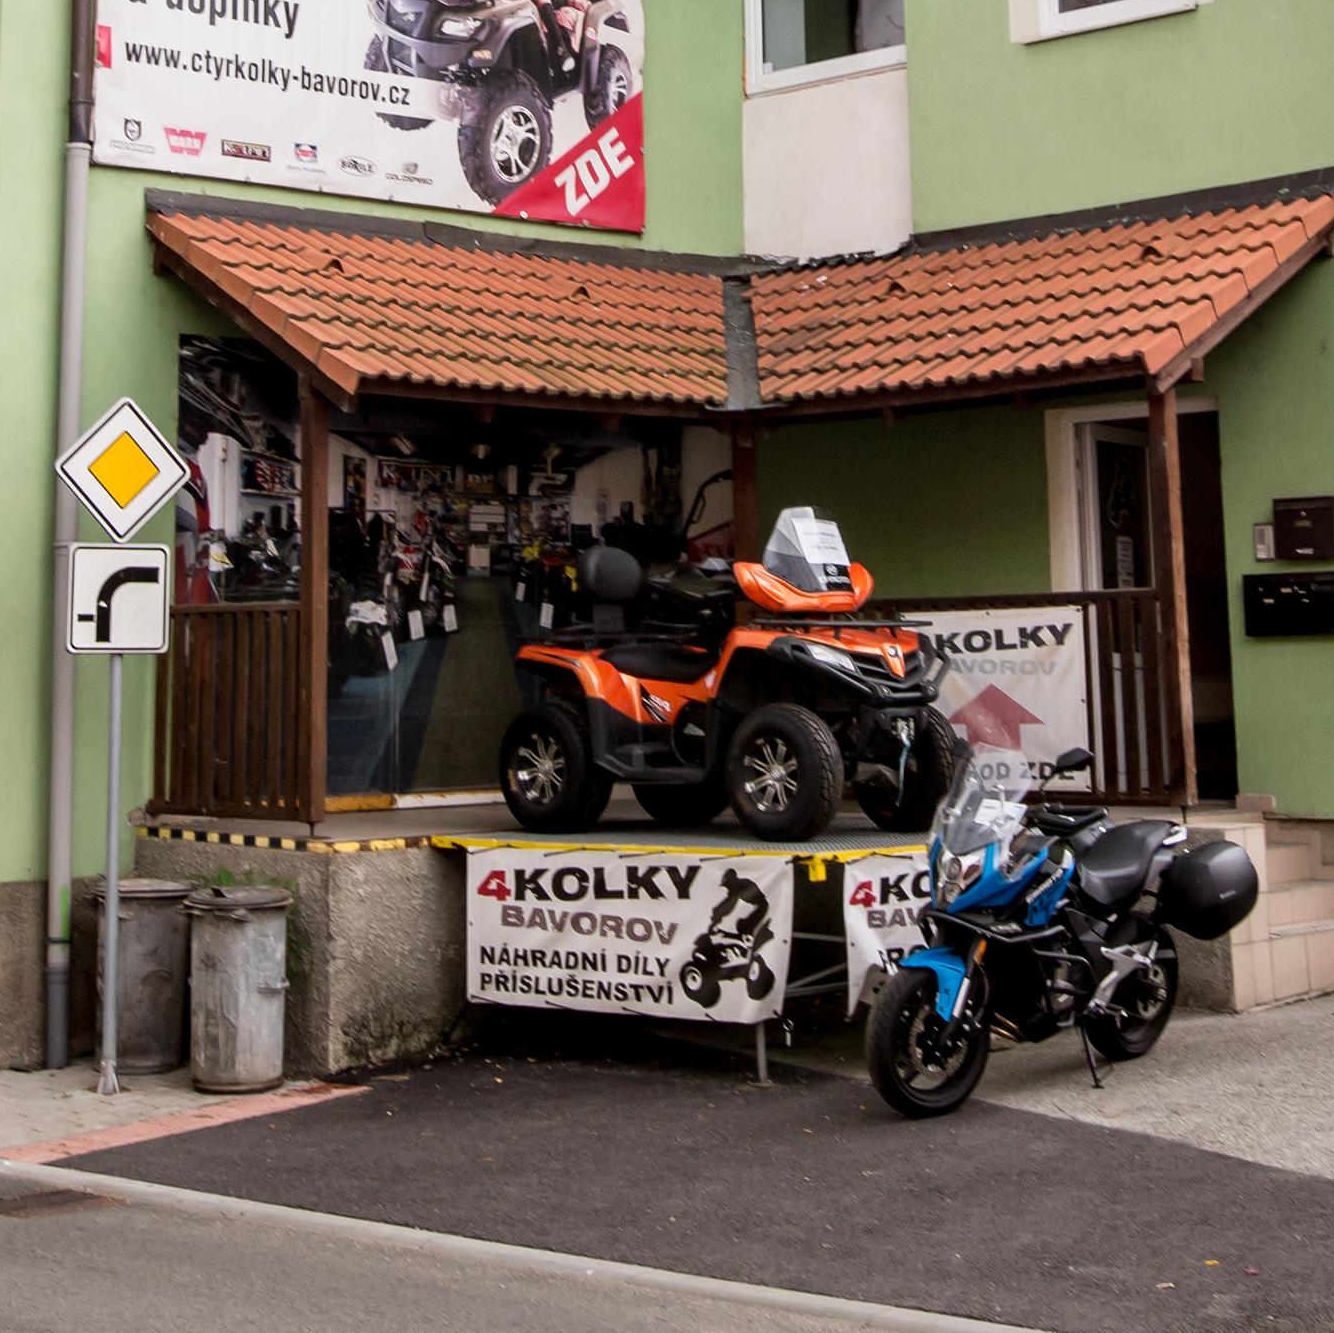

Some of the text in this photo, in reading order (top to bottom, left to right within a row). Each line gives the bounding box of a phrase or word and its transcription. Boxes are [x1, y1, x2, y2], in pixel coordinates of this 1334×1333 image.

[125, 40, 411, 106] www.ctyrkolky-bavorov.cz
[554, 125, 636, 216] ZDE
[934, 623, 1073, 654] KOLKY
[948, 658, 1056, 676] AVOROV
[477, 865, 702, 903] 4KOLKY
[849, 870, 932, 907] 4KO
[501, 905, 678, 945] BAVOROV
[867, 907, 921, 928] BAV
[479, 943, 670, 978] NÁHRADNÍ DÍLY
[479, 968, 675, 1007] PŘÍSLUŠENSTVÍ
